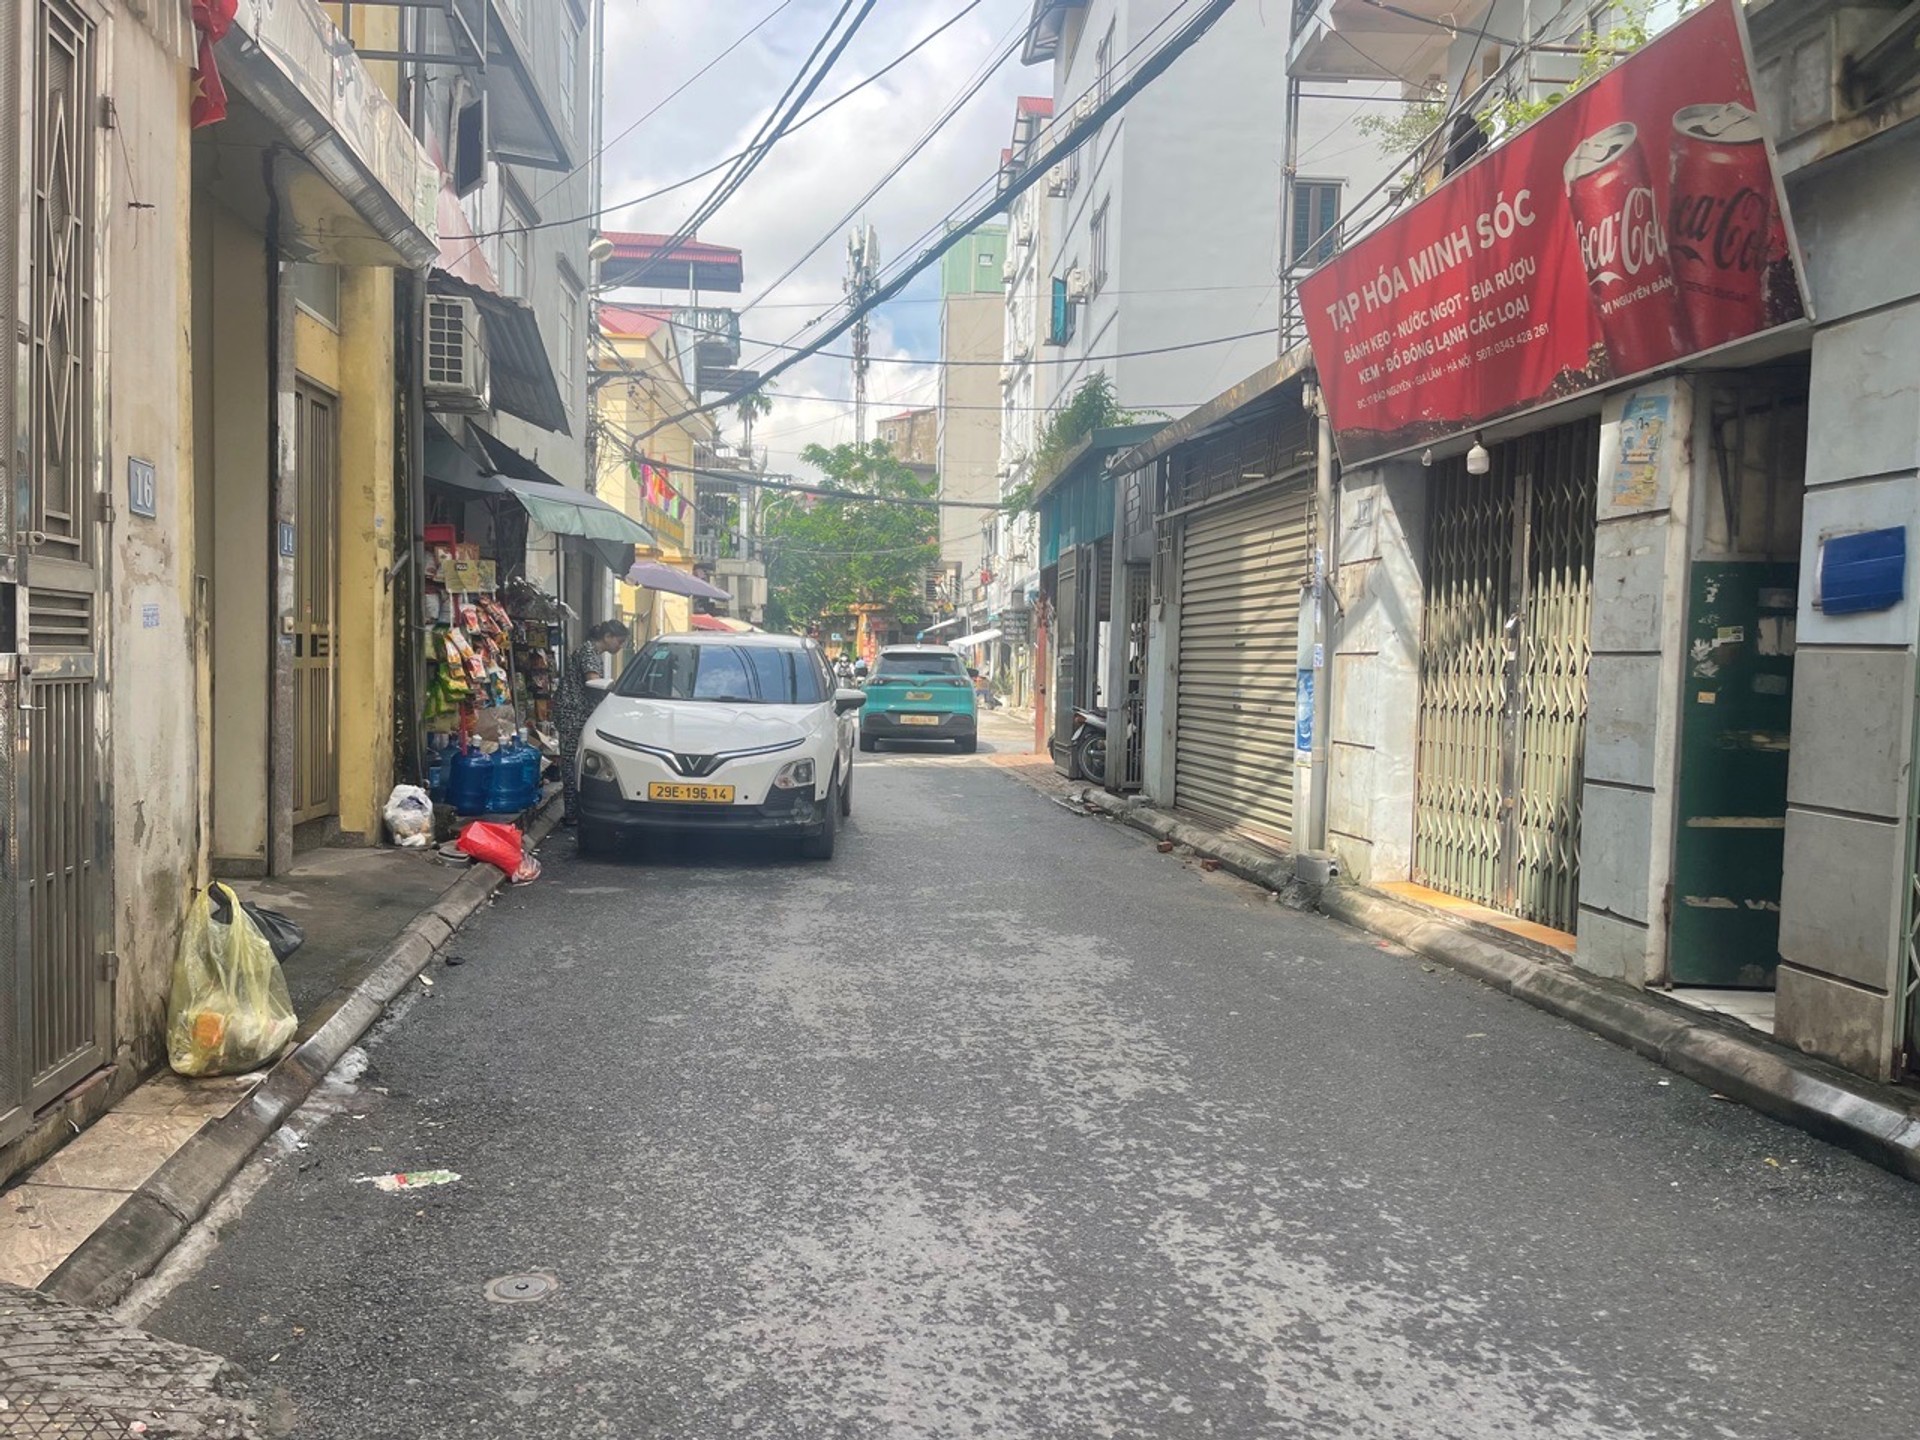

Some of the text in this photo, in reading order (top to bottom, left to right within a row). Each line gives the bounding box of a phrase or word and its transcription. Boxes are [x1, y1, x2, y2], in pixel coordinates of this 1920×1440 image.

[1326, 189, 1536, 333] TẠP HÓA MINH SÓC
[1344, 343, 1371, 364] BÁNH
[1370, 330, 1391, 352] KẸO
[1397, 310, 1429, 338] NƯỚC
[1430, 293, 1462, 322] NGỌT
[1471, 279, 1495, 302] BIA
[1495, 255, 1536, 291] RƯỢU
[1612, 285, 1650, 309] NGUYÊN
[1358, 363, 1380, 385] KEM
[1385, 347, 1401, 372] ĐỒ
[1402, 339, 1434, 365] ĐÔNG
[1435, 323, 1468, 352] LẠNH
[1469, 310, 1496, 335] CÁC
[1497, 294, 1530, 324] LOẠI
[1415, 373, 1427, 385] GIA
[136, 467, 153, 508] 16
[656, 786, 727, 799] 29E-196.14
